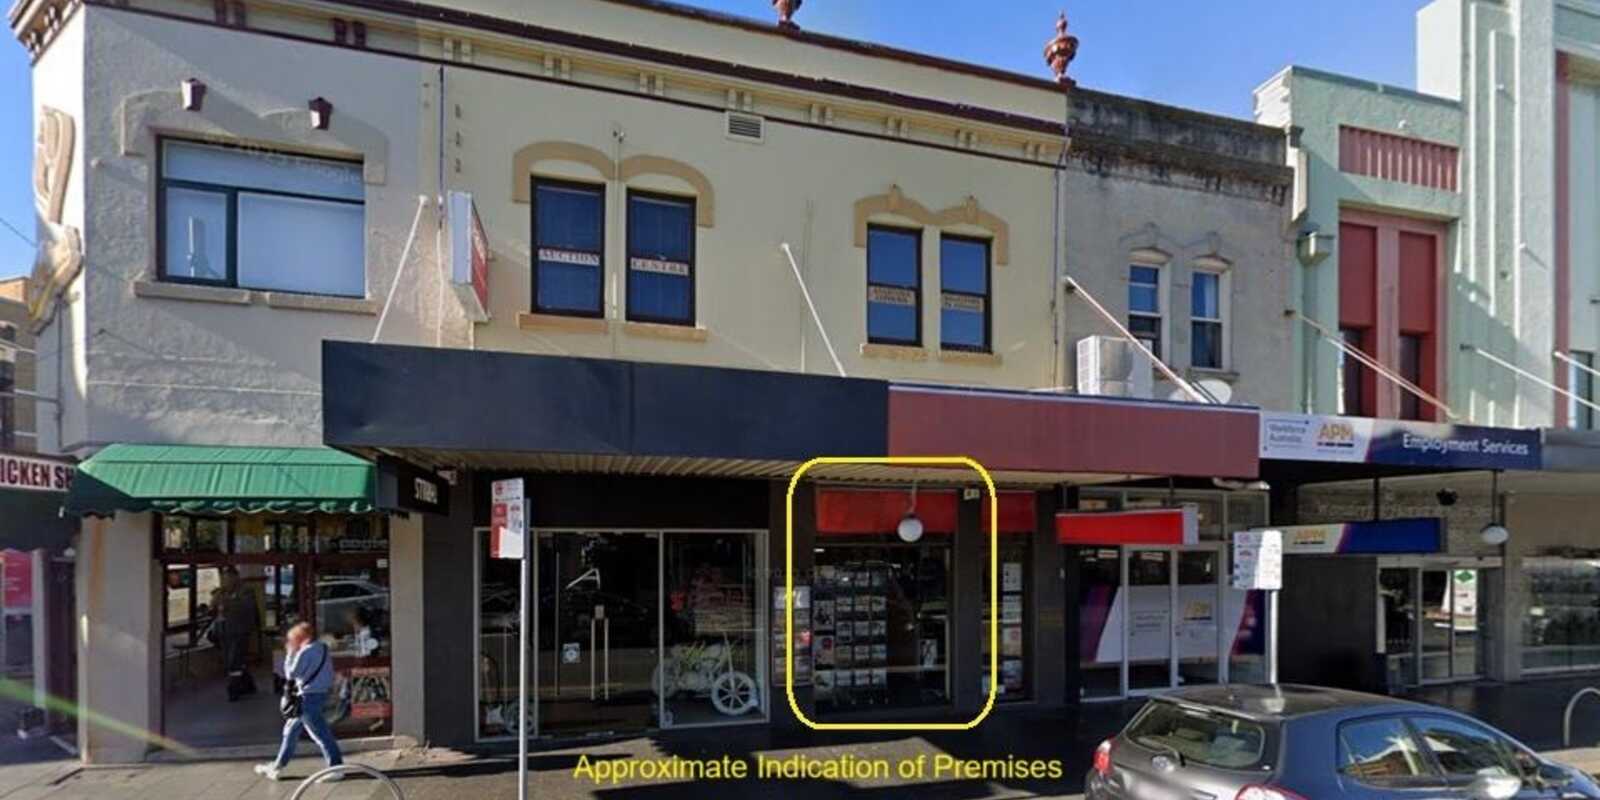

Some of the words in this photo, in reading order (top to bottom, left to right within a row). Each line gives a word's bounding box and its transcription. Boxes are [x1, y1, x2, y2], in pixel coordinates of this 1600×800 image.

[540, 249, 599, 266] AUCTION
[632, 258, 686, 275] CENTRE
[1317, 423, 1354, 441] APM
[1402, 433, 1479, 453] Employment
[1482, 436, 1529, 456] Services
[0, 458, 50, 487] ICKEN
